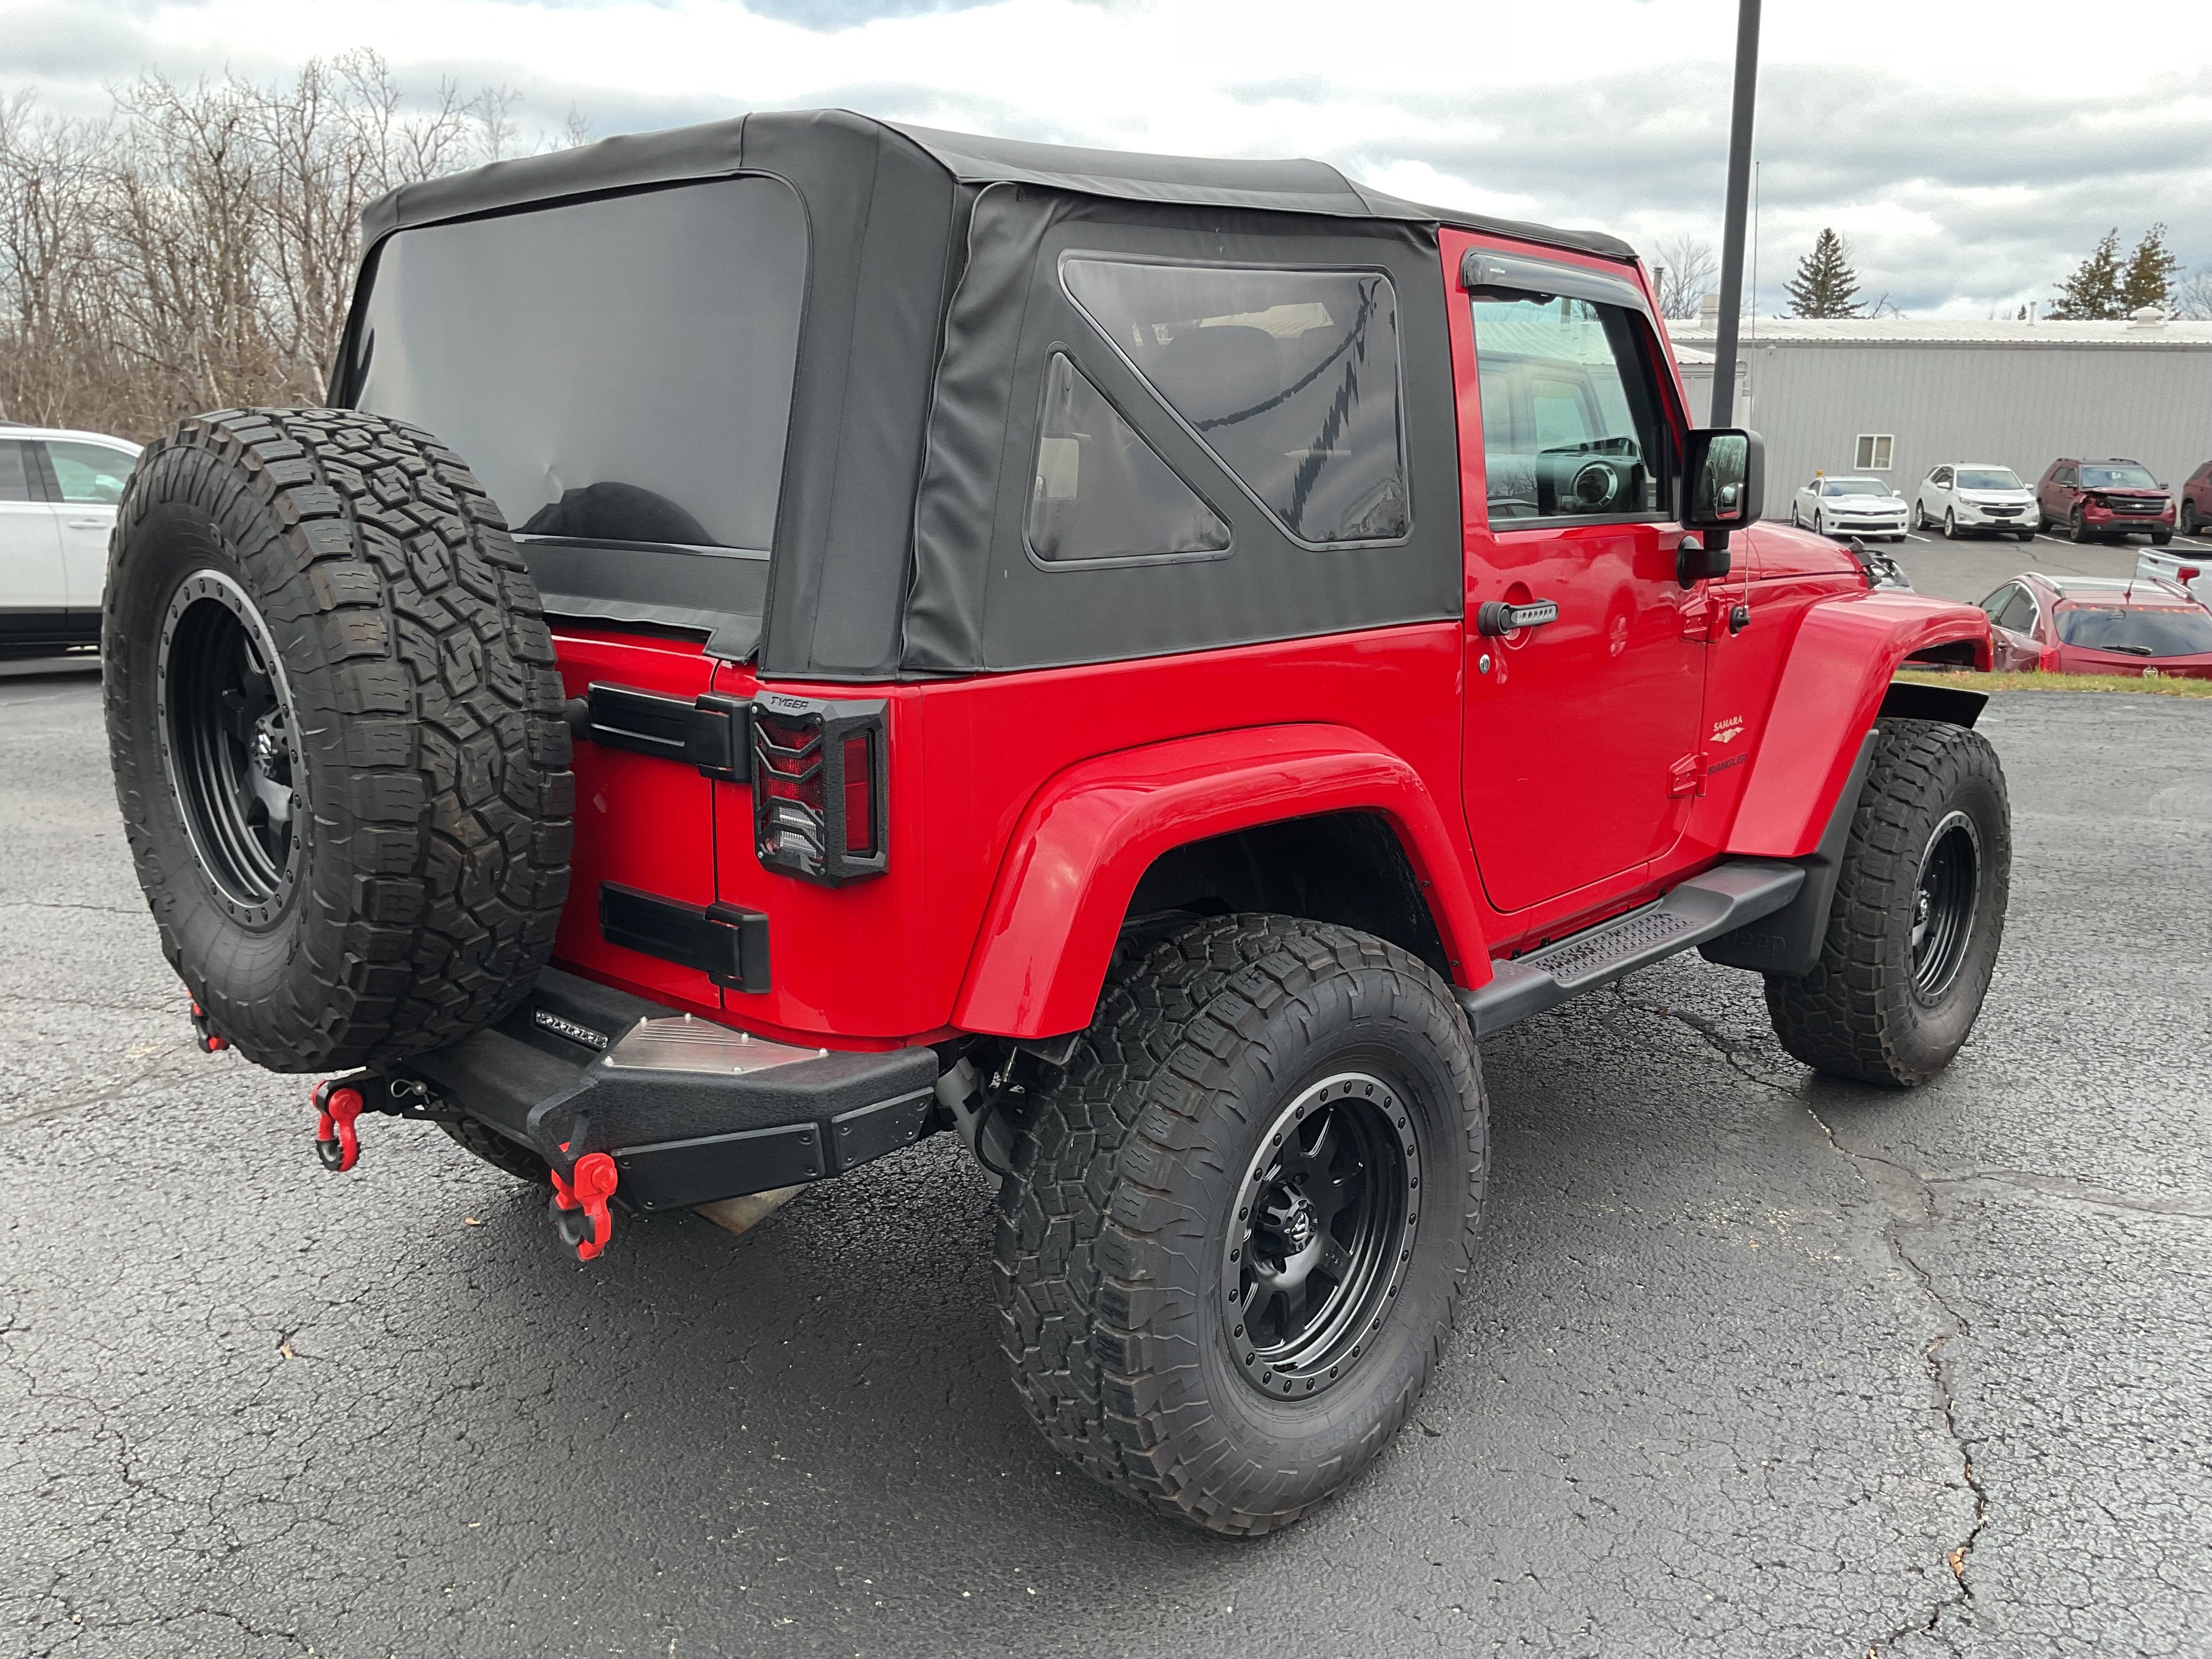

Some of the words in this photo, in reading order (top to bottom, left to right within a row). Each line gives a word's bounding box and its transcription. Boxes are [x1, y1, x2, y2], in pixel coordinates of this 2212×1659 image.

[771, 696, 809, 710] TYGER
[1713, 715, 1743, 731] SAHARA
[1708, 754, 1747, 775] RANGLER
